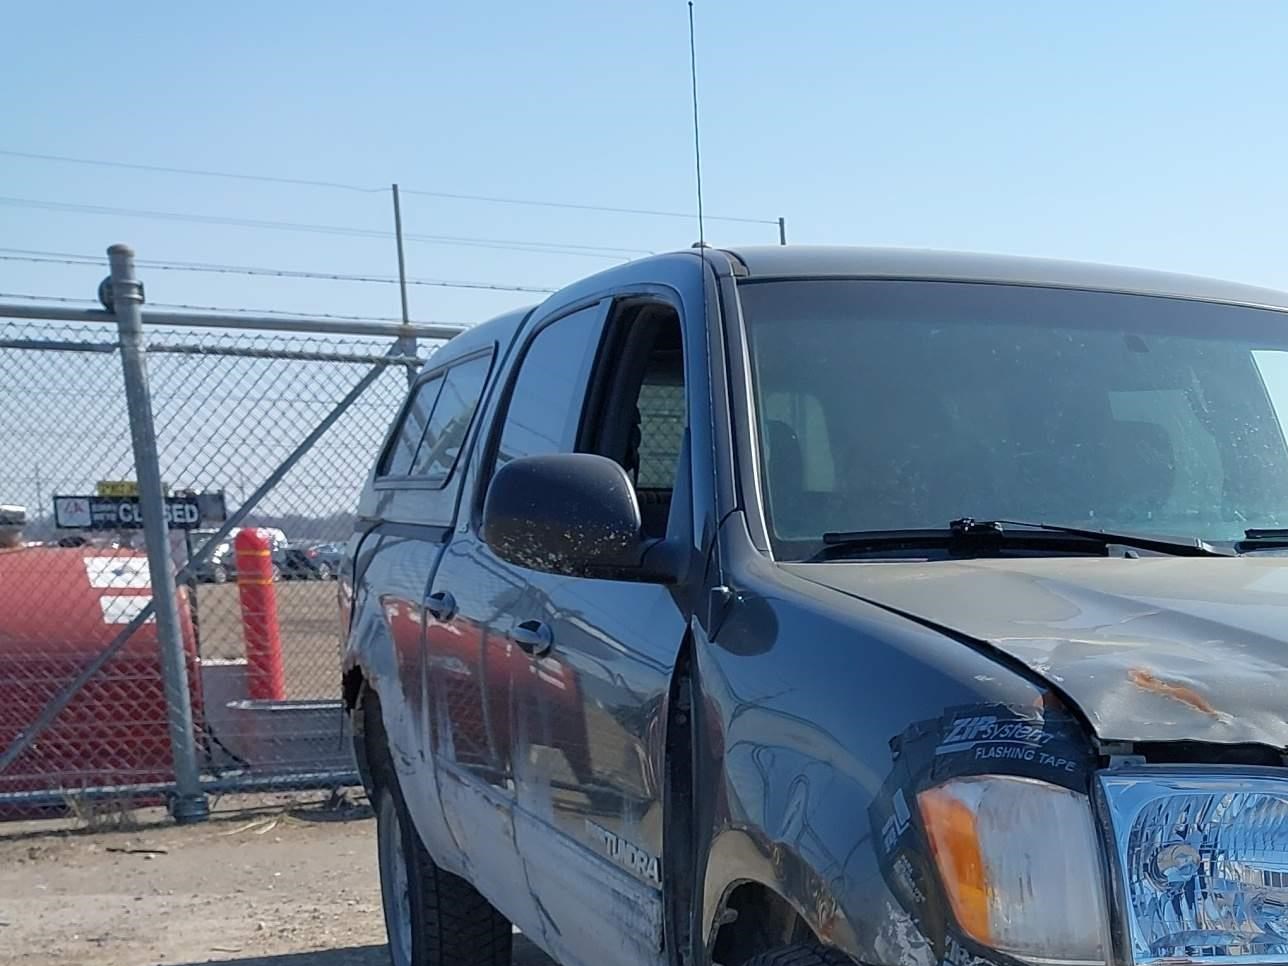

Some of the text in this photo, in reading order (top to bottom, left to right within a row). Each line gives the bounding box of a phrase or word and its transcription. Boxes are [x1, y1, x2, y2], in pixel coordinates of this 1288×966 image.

[119, 503, 198, 523] CLSED
[976, 746, 1077, 772] FLASHING TAPE
